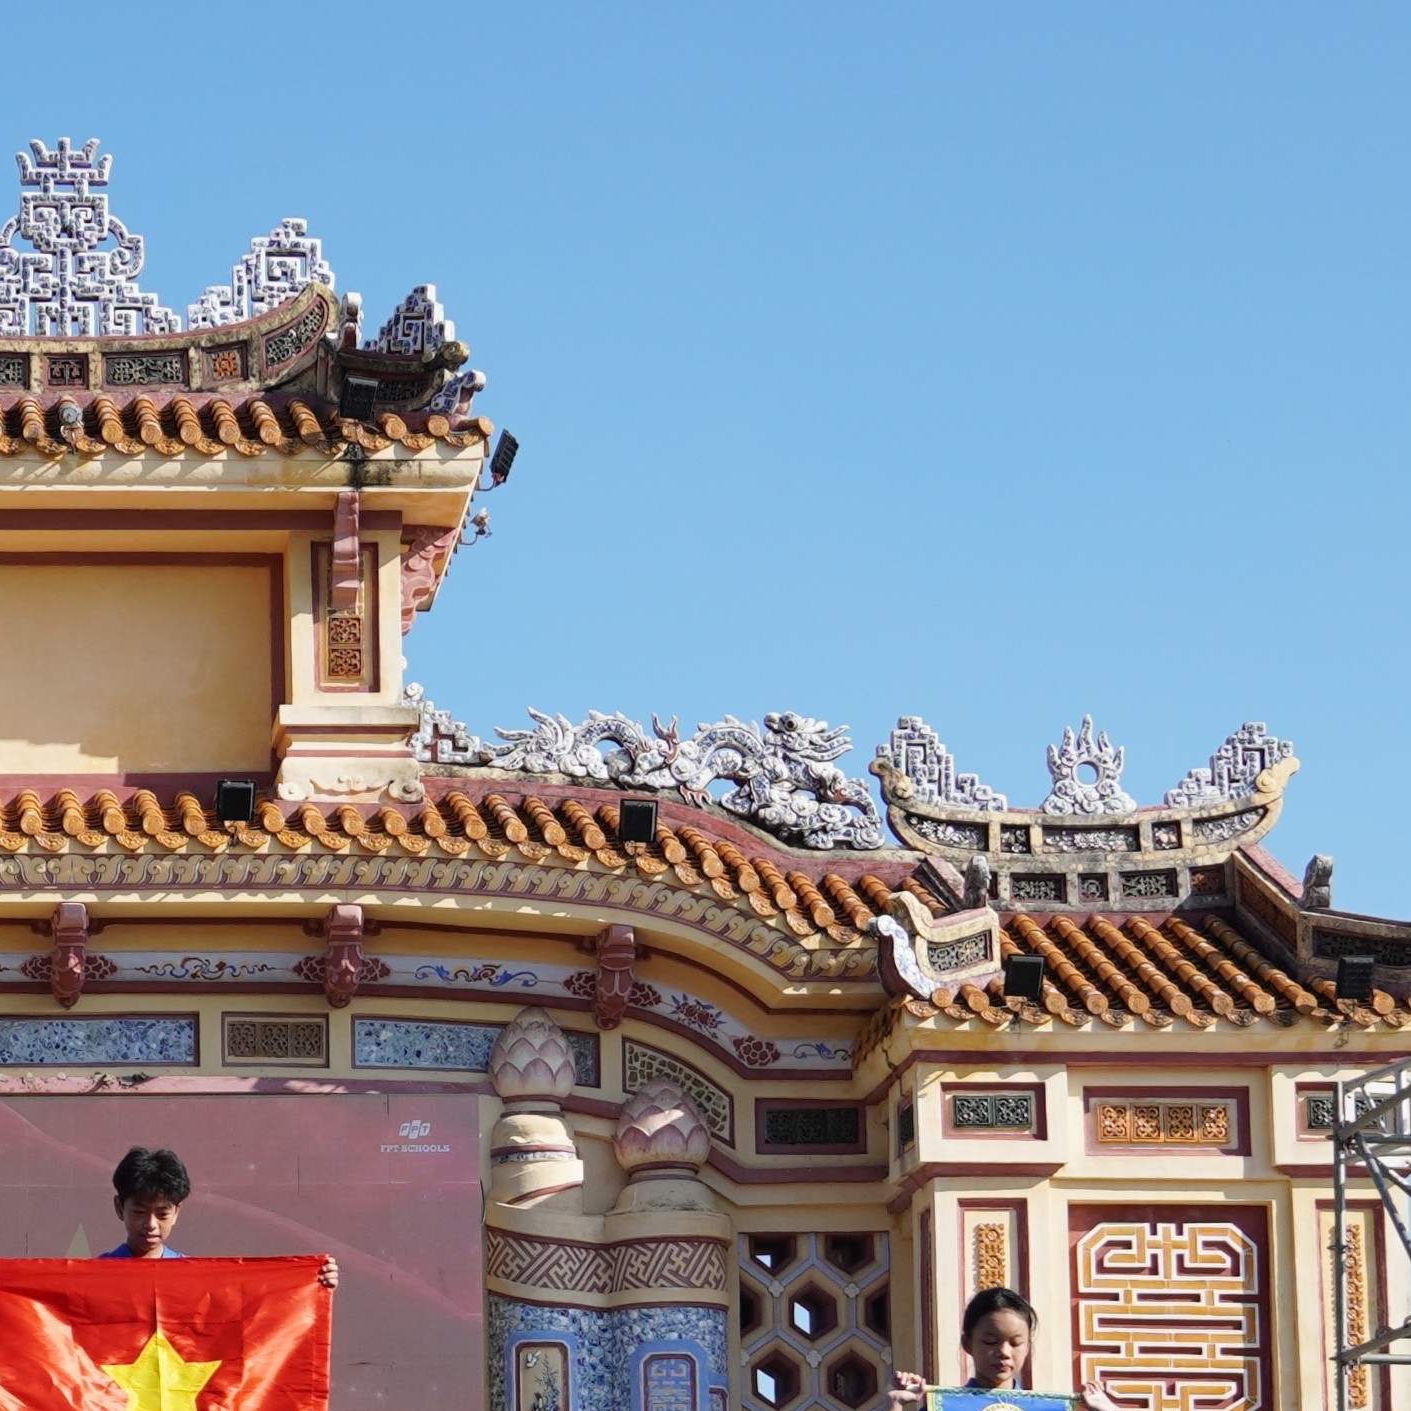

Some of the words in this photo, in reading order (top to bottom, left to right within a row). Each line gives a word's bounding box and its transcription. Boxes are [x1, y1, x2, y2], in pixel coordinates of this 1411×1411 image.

[399, 1121, 431, 1138] FPT
[380, 1144, 400, 1153] FPT
[401, 1144, 450, 1153] SCHOOLS
